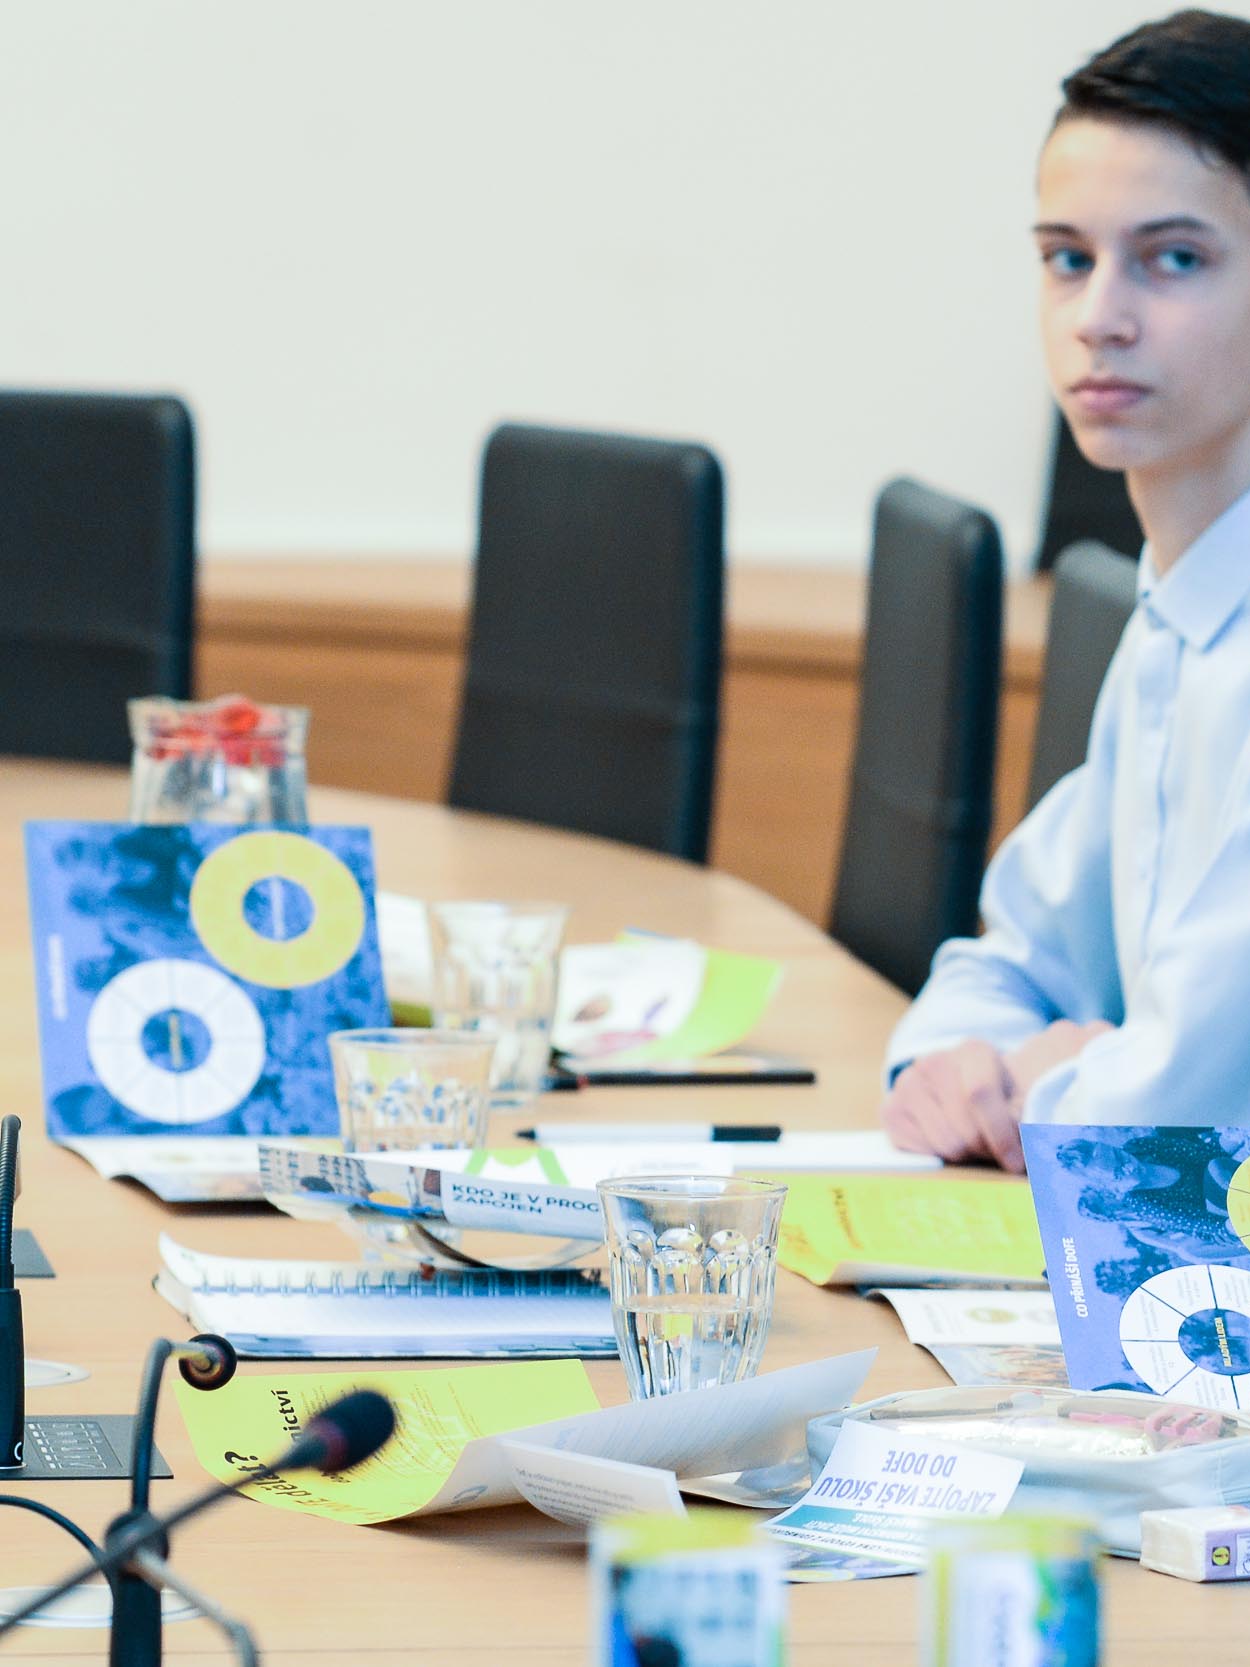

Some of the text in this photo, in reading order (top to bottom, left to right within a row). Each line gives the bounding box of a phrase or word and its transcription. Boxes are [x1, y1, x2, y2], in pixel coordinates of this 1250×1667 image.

[453, 1184, 494, 1198] KDO
[502, 1190, 521, 1202] JE
[528, 1194, 540, 1204] V
[453, 1194, 542, 1214] ZAPOJEN
[1062, 1237, 1089, 1318] CO PŘINÁŠÍ DOFE
[881, 1449, 957, 1478] DO DOFE
[814, 1477, 878, 1507] ŠKOLU
[919, 1483, 996, 1514] ZAPOJTE
